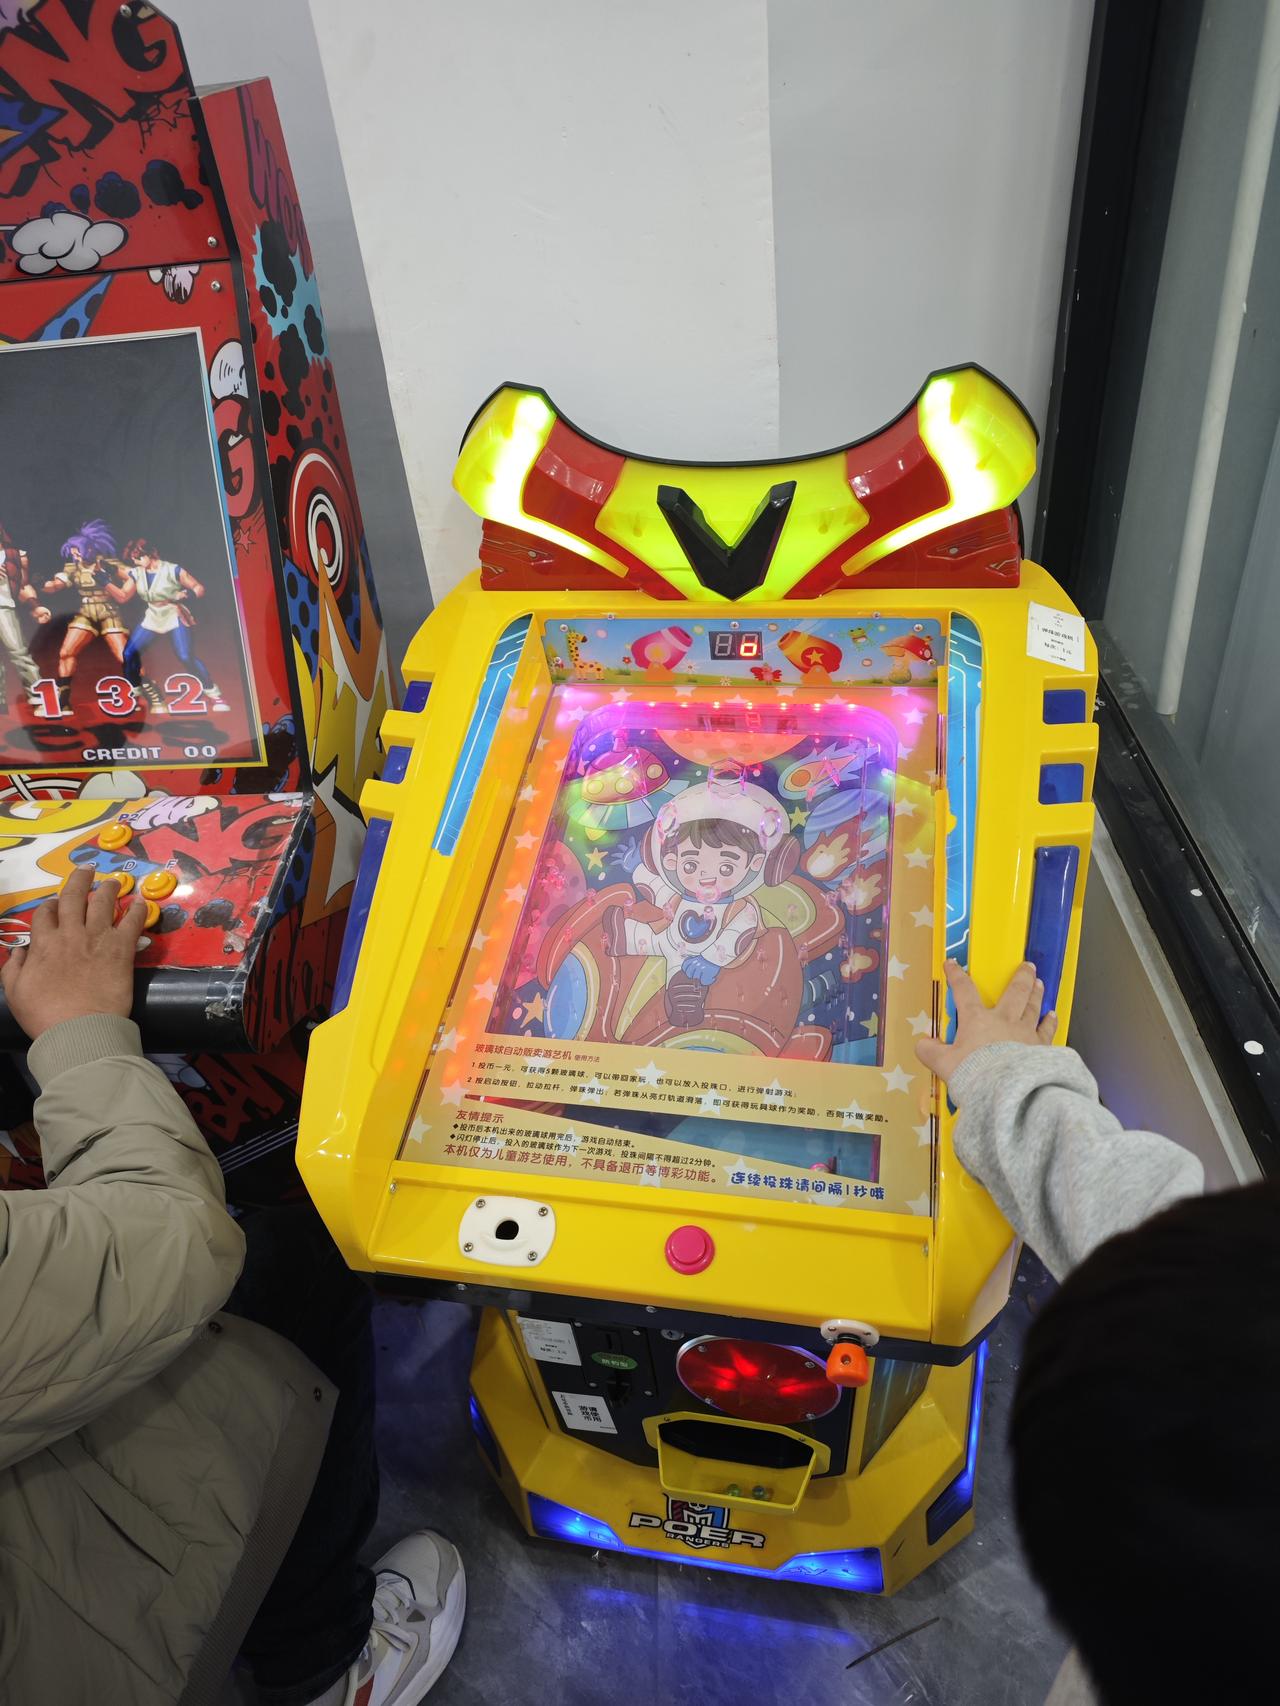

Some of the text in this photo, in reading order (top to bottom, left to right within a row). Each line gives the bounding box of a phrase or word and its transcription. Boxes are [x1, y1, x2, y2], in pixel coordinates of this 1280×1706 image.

[96, 676, 137, 716] 3
[164, 673, 208, 714] 2
[82, 745, 217, 761] CREDIT 00
[118, 813, 139, 823] P2
[122, 858, 179, 872] D F
[474, 1043, 572, 1060] 玻璃球自动贩卖游艺机
[455, 1110, 505, 1124] 友情提示
[629, 1512, 766, 1549] POER
